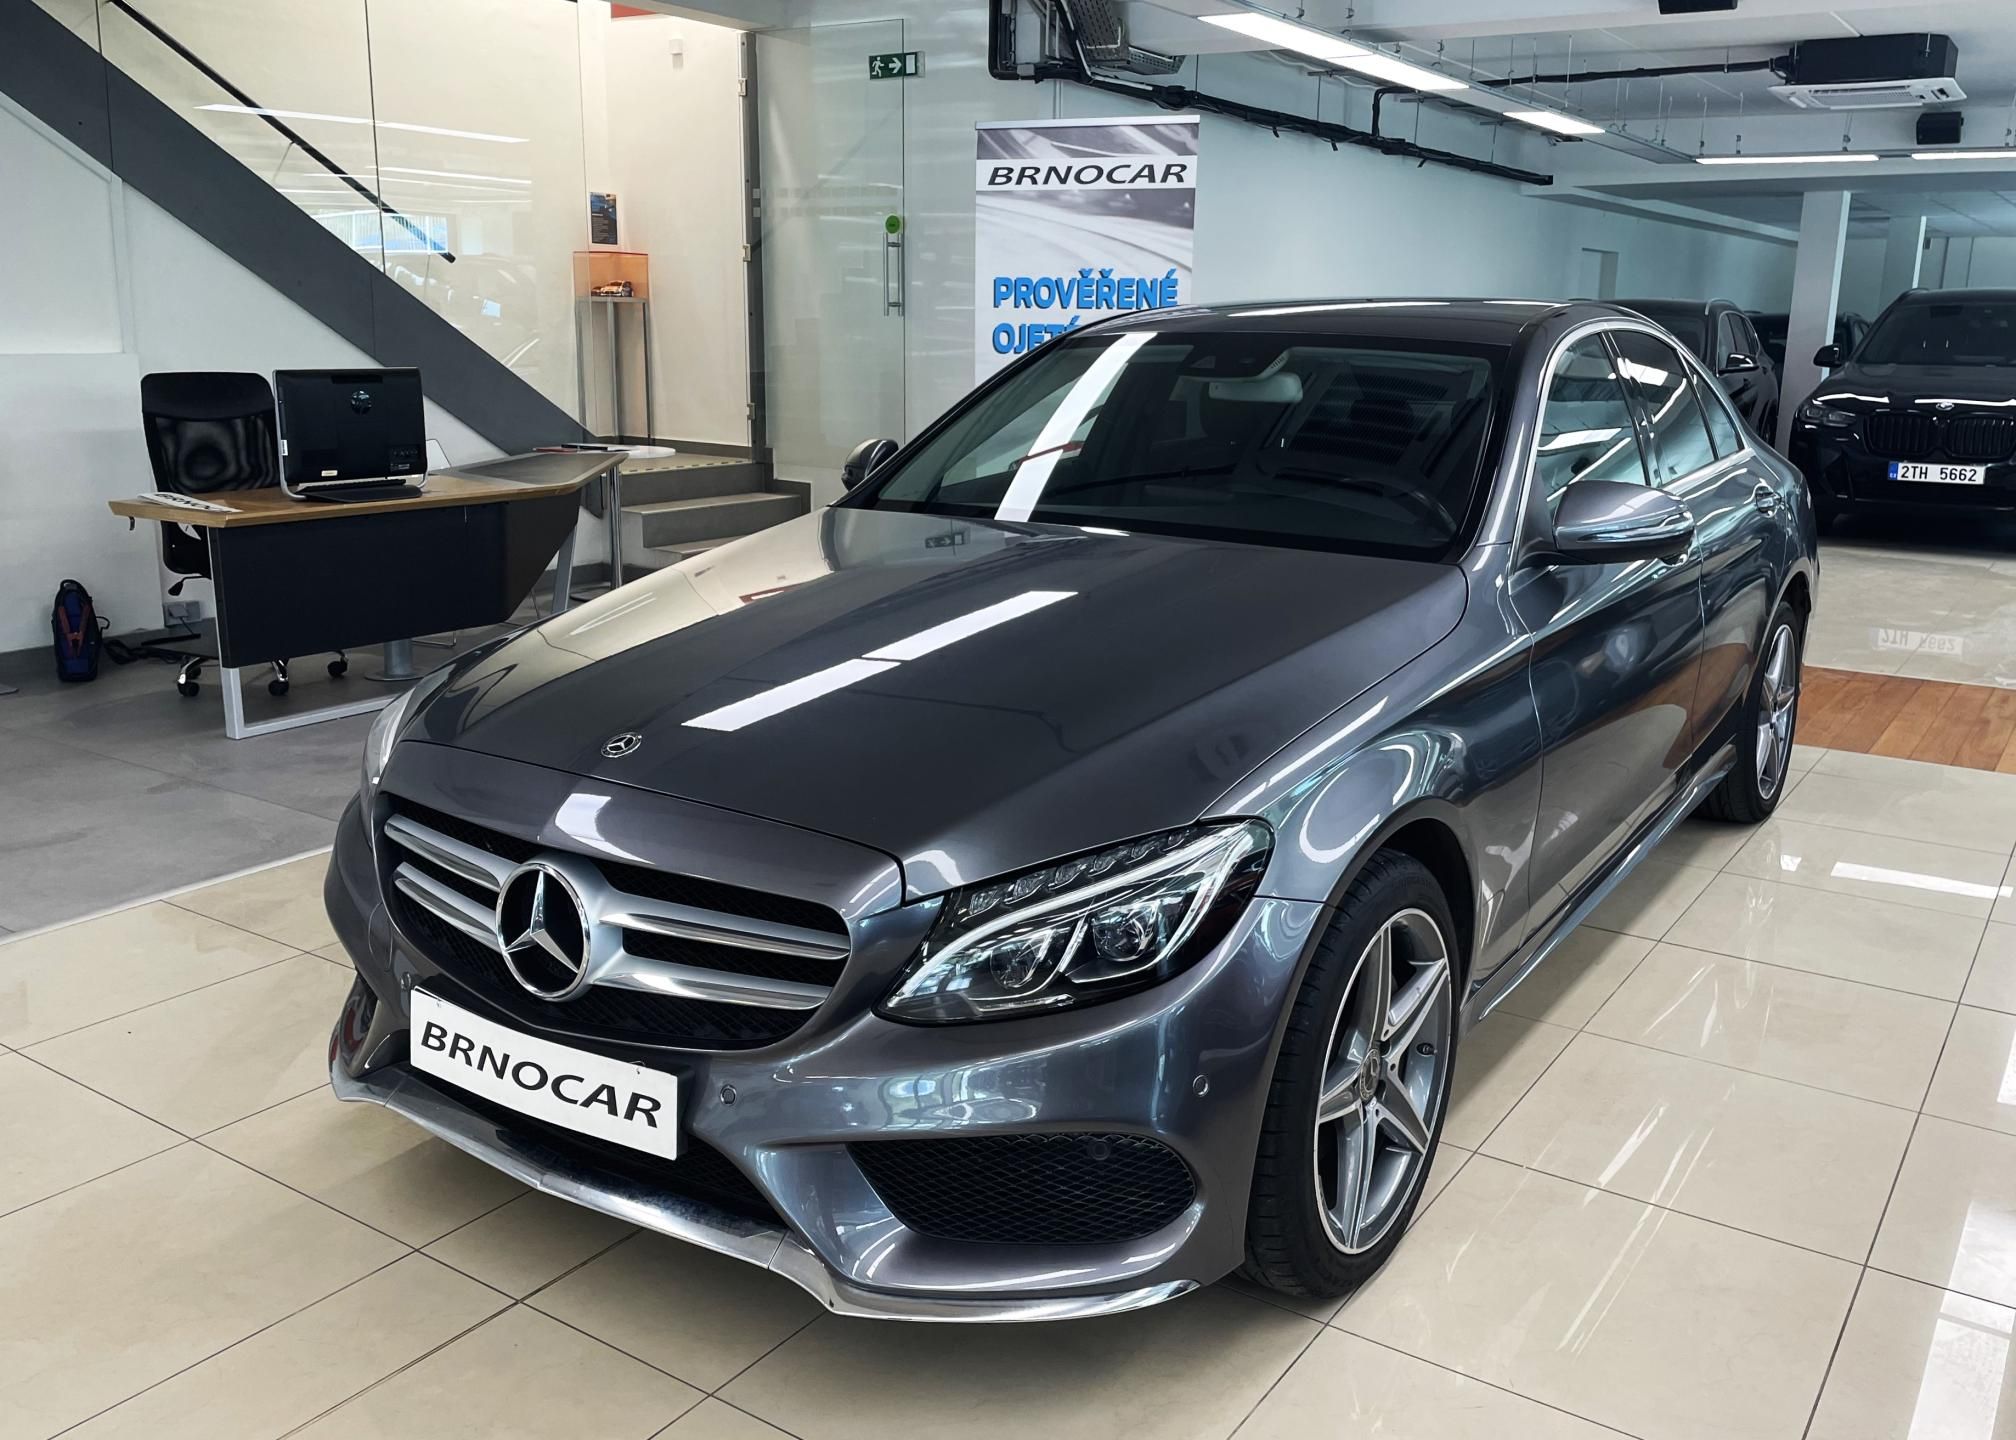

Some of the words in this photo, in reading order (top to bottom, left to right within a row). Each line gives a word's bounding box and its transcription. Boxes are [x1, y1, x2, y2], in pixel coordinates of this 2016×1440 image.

[987, 163, 1188, 186] BRNOCAR
[993, 268, 1179, 310] PROVĚŘENÉ
[1901, 465, 1928, 480] 2TH
[1940, 467, 1977, 482] 5662
[420, 1021, 662, 1129] BRNOCAR
